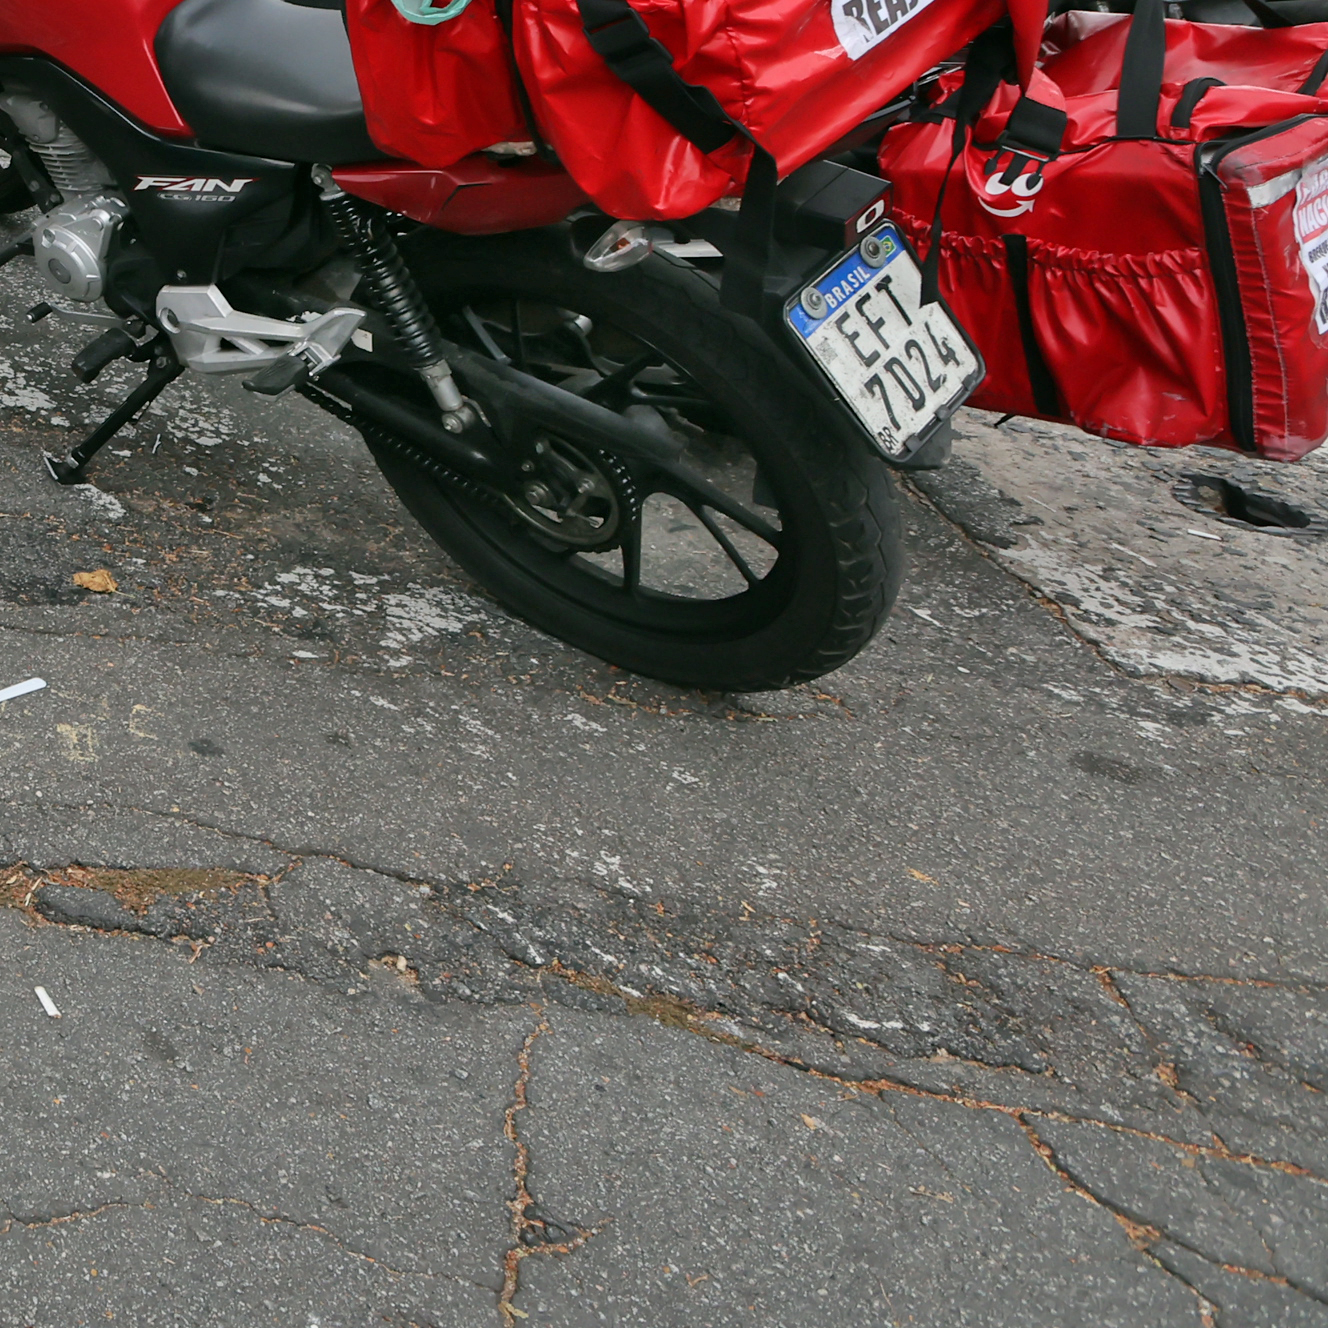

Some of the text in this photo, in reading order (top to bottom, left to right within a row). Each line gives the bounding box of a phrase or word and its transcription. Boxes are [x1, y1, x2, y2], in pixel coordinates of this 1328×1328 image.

[133, 175, 256, 193] FAN
[195, 194, 237, 203] 160
[824, 265, 871, 310] BRASIL
[835, 274, 913, 369] EFT
